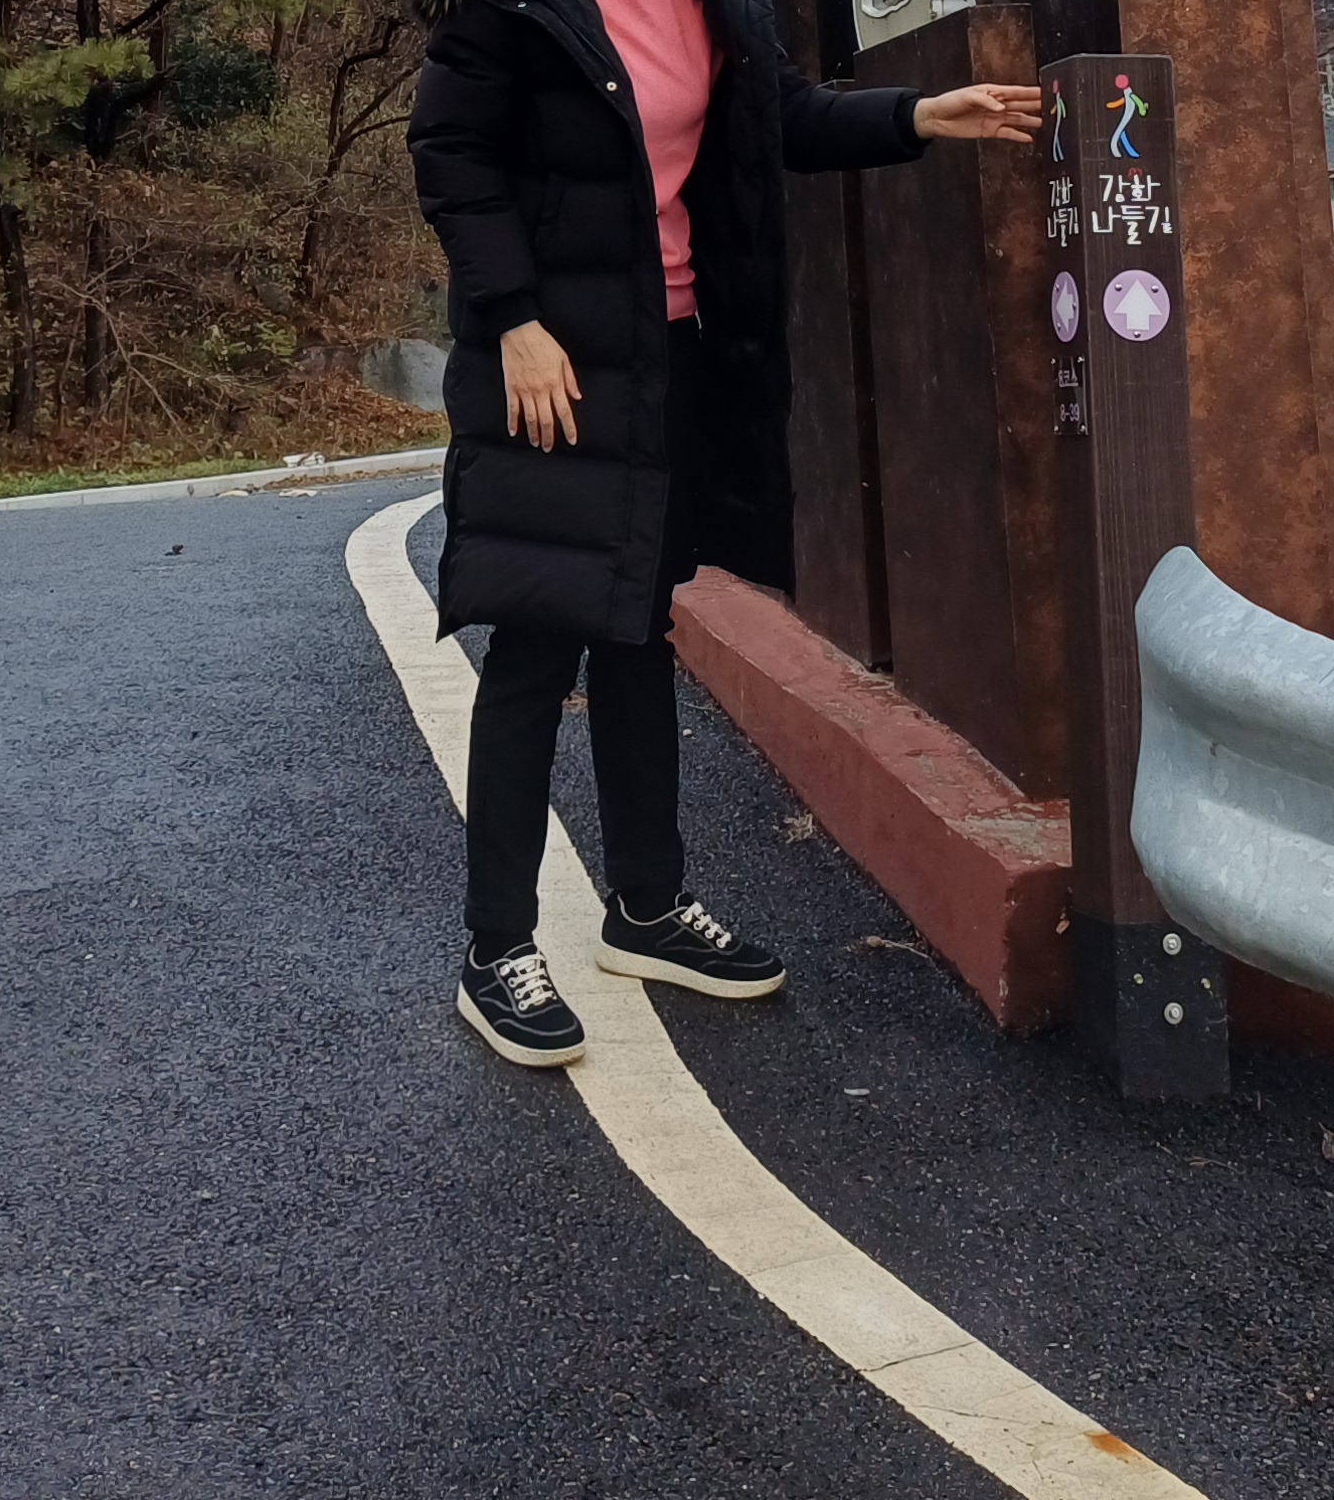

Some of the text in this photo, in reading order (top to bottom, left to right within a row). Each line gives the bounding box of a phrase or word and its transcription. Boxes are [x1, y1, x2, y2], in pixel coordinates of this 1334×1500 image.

[1049, 177, 1074, 207] 강화
[1099, 174, 1161, 202] 강화
[1047, 206, 1079, 247] 나들길
[1091, 205, 1173, 245] 나들길
